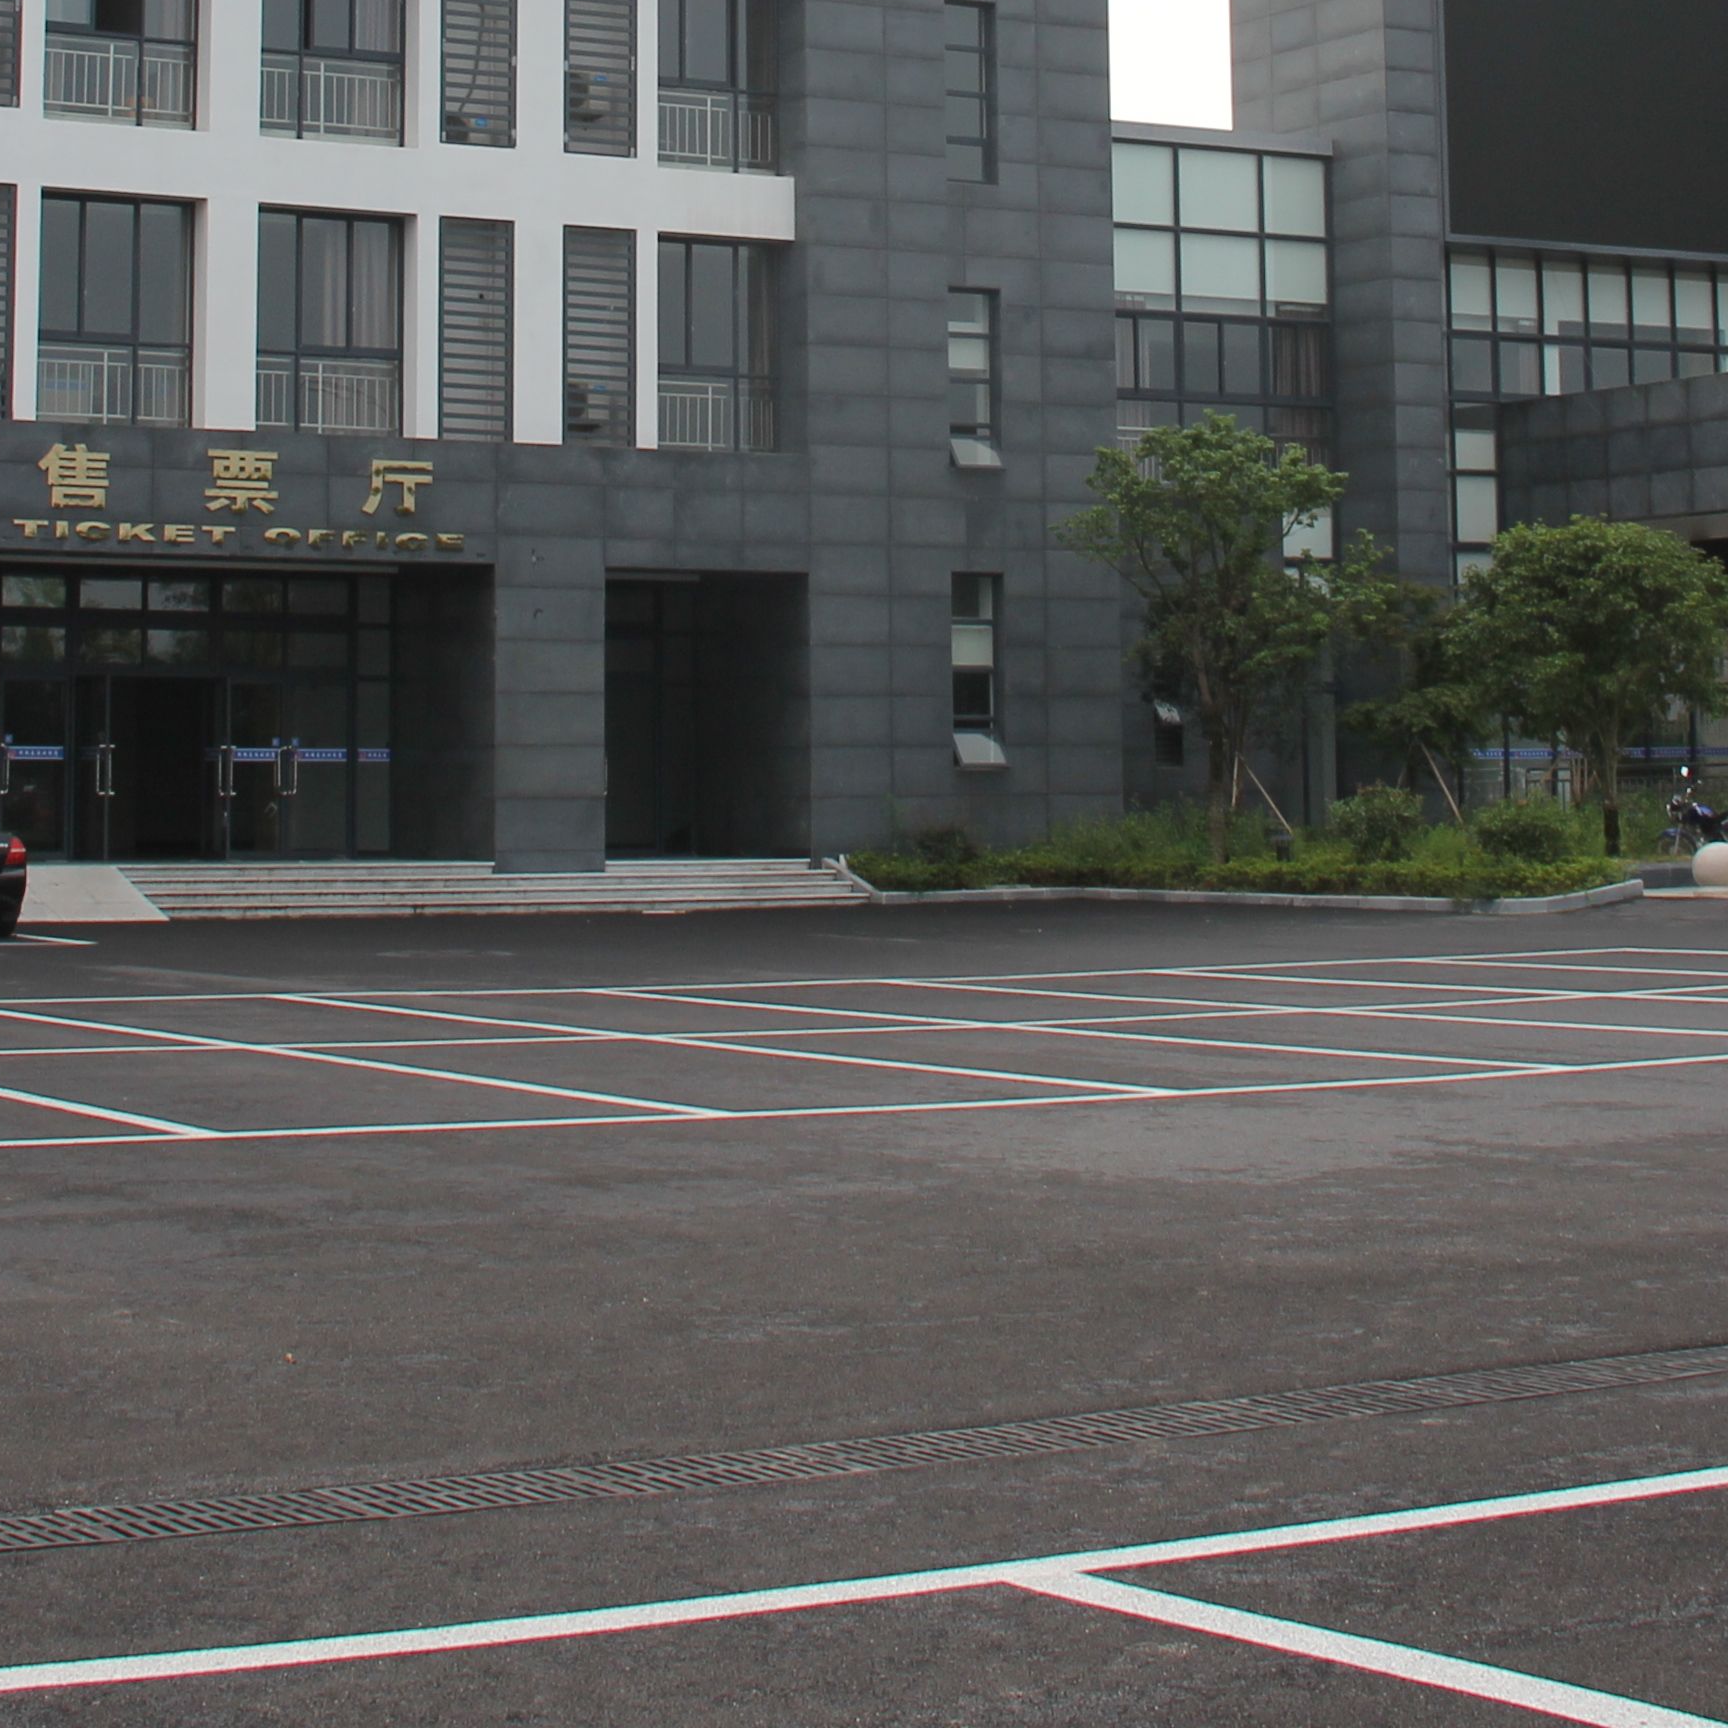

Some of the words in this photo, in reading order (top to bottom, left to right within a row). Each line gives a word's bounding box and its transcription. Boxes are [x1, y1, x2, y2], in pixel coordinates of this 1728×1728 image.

[36, 442, 434, 516] 售票厅
[13, 518, 237, 546] TICKET
[264, 526, 466, 553] OFFICE
